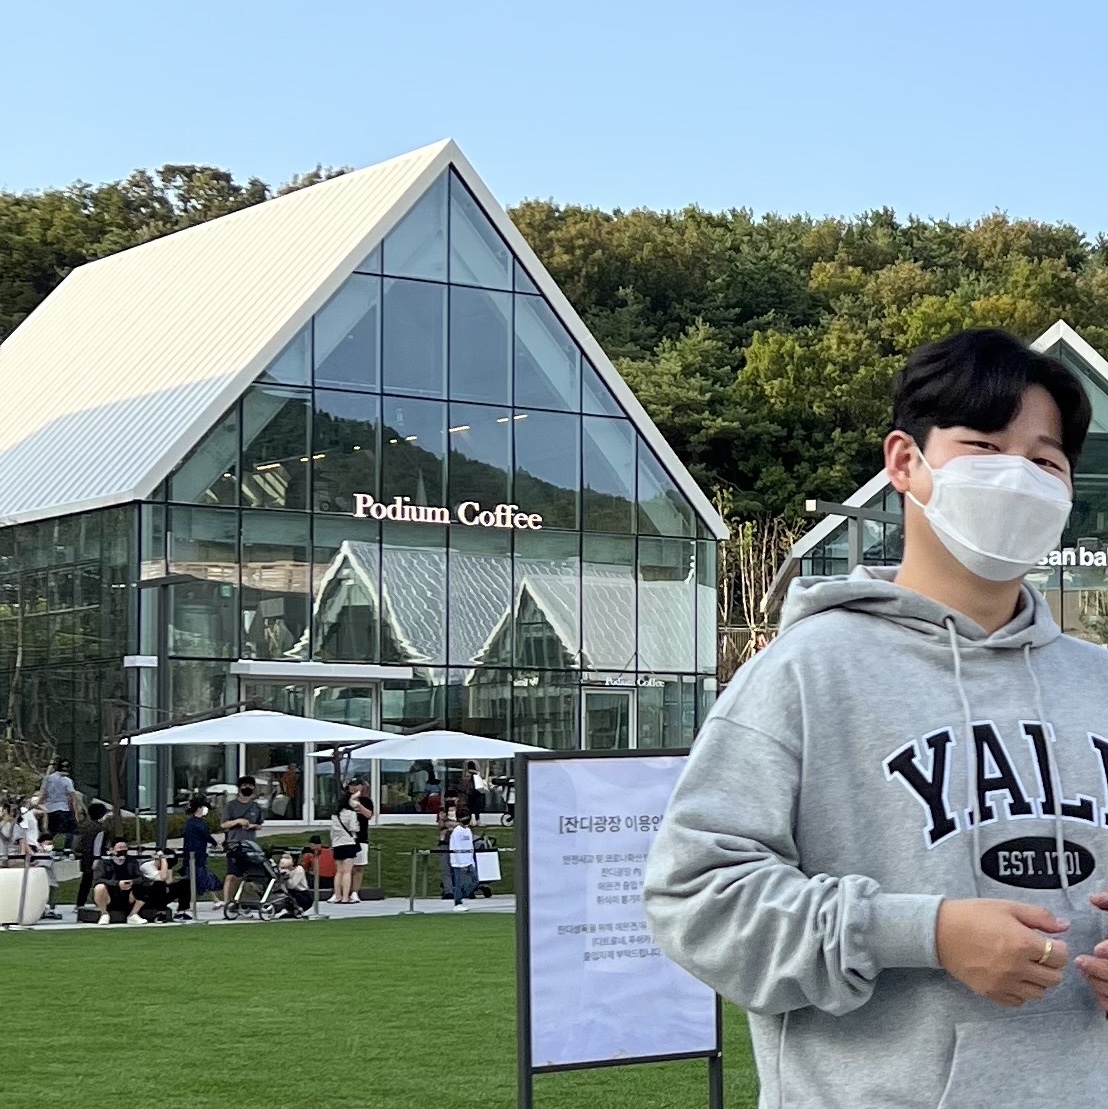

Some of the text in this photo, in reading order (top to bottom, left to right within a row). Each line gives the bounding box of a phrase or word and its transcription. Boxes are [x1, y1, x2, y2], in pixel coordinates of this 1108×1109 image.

[353, 493, 543, 529] Podium Coffee
[559, 815, 621, 834] [잔디광장
